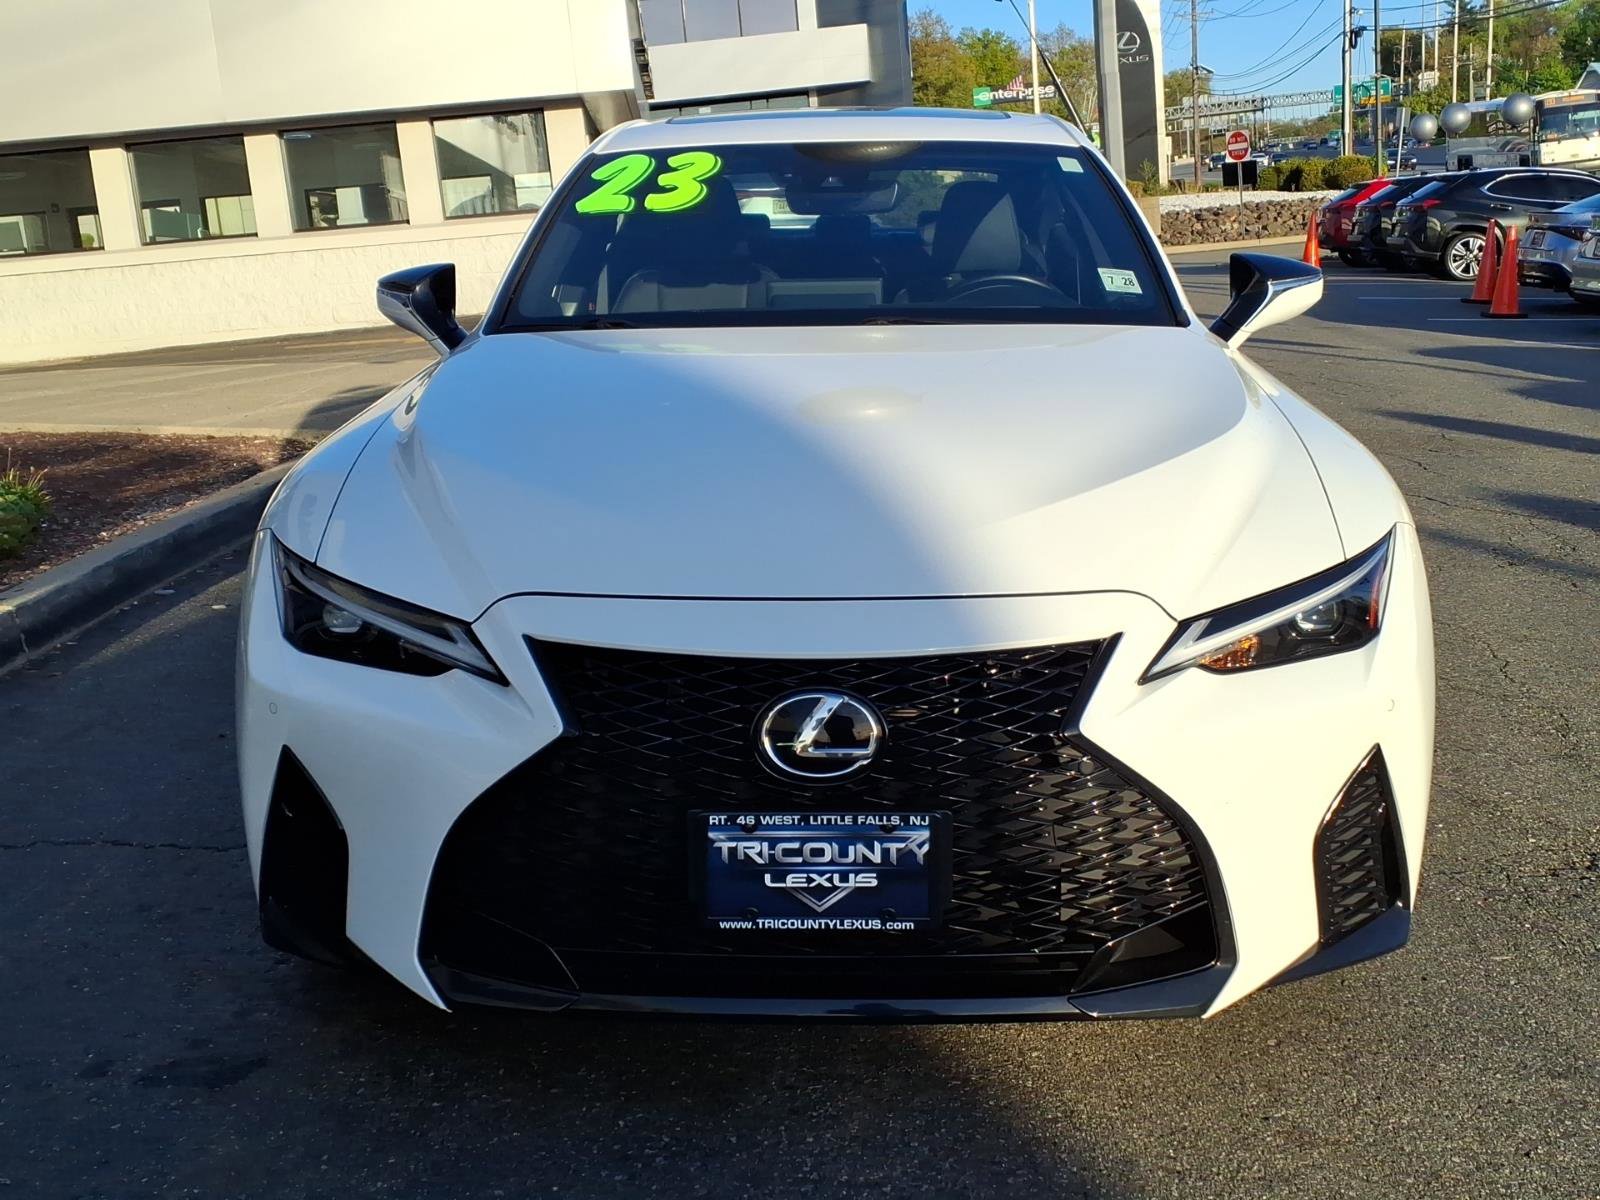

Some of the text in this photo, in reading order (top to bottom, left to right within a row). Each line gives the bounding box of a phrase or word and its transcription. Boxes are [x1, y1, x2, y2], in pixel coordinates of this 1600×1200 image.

[1119, 55, 1149, 64] XUS
[977, 85, 1055, 101] enterprse
[575, 151, 722, 214] 23
[1107, 275, 1135, 286] 7 28
[709, 815, 929, 827] RT. 46 WEST, LITTLE FALLS, NJ
[713, 840, 931, 866] TRI-COUNTY
[764, 873, 878, 887] LEXUS
[719, 919, 914, 930] www.TRICOUNTYLEXUS.com
